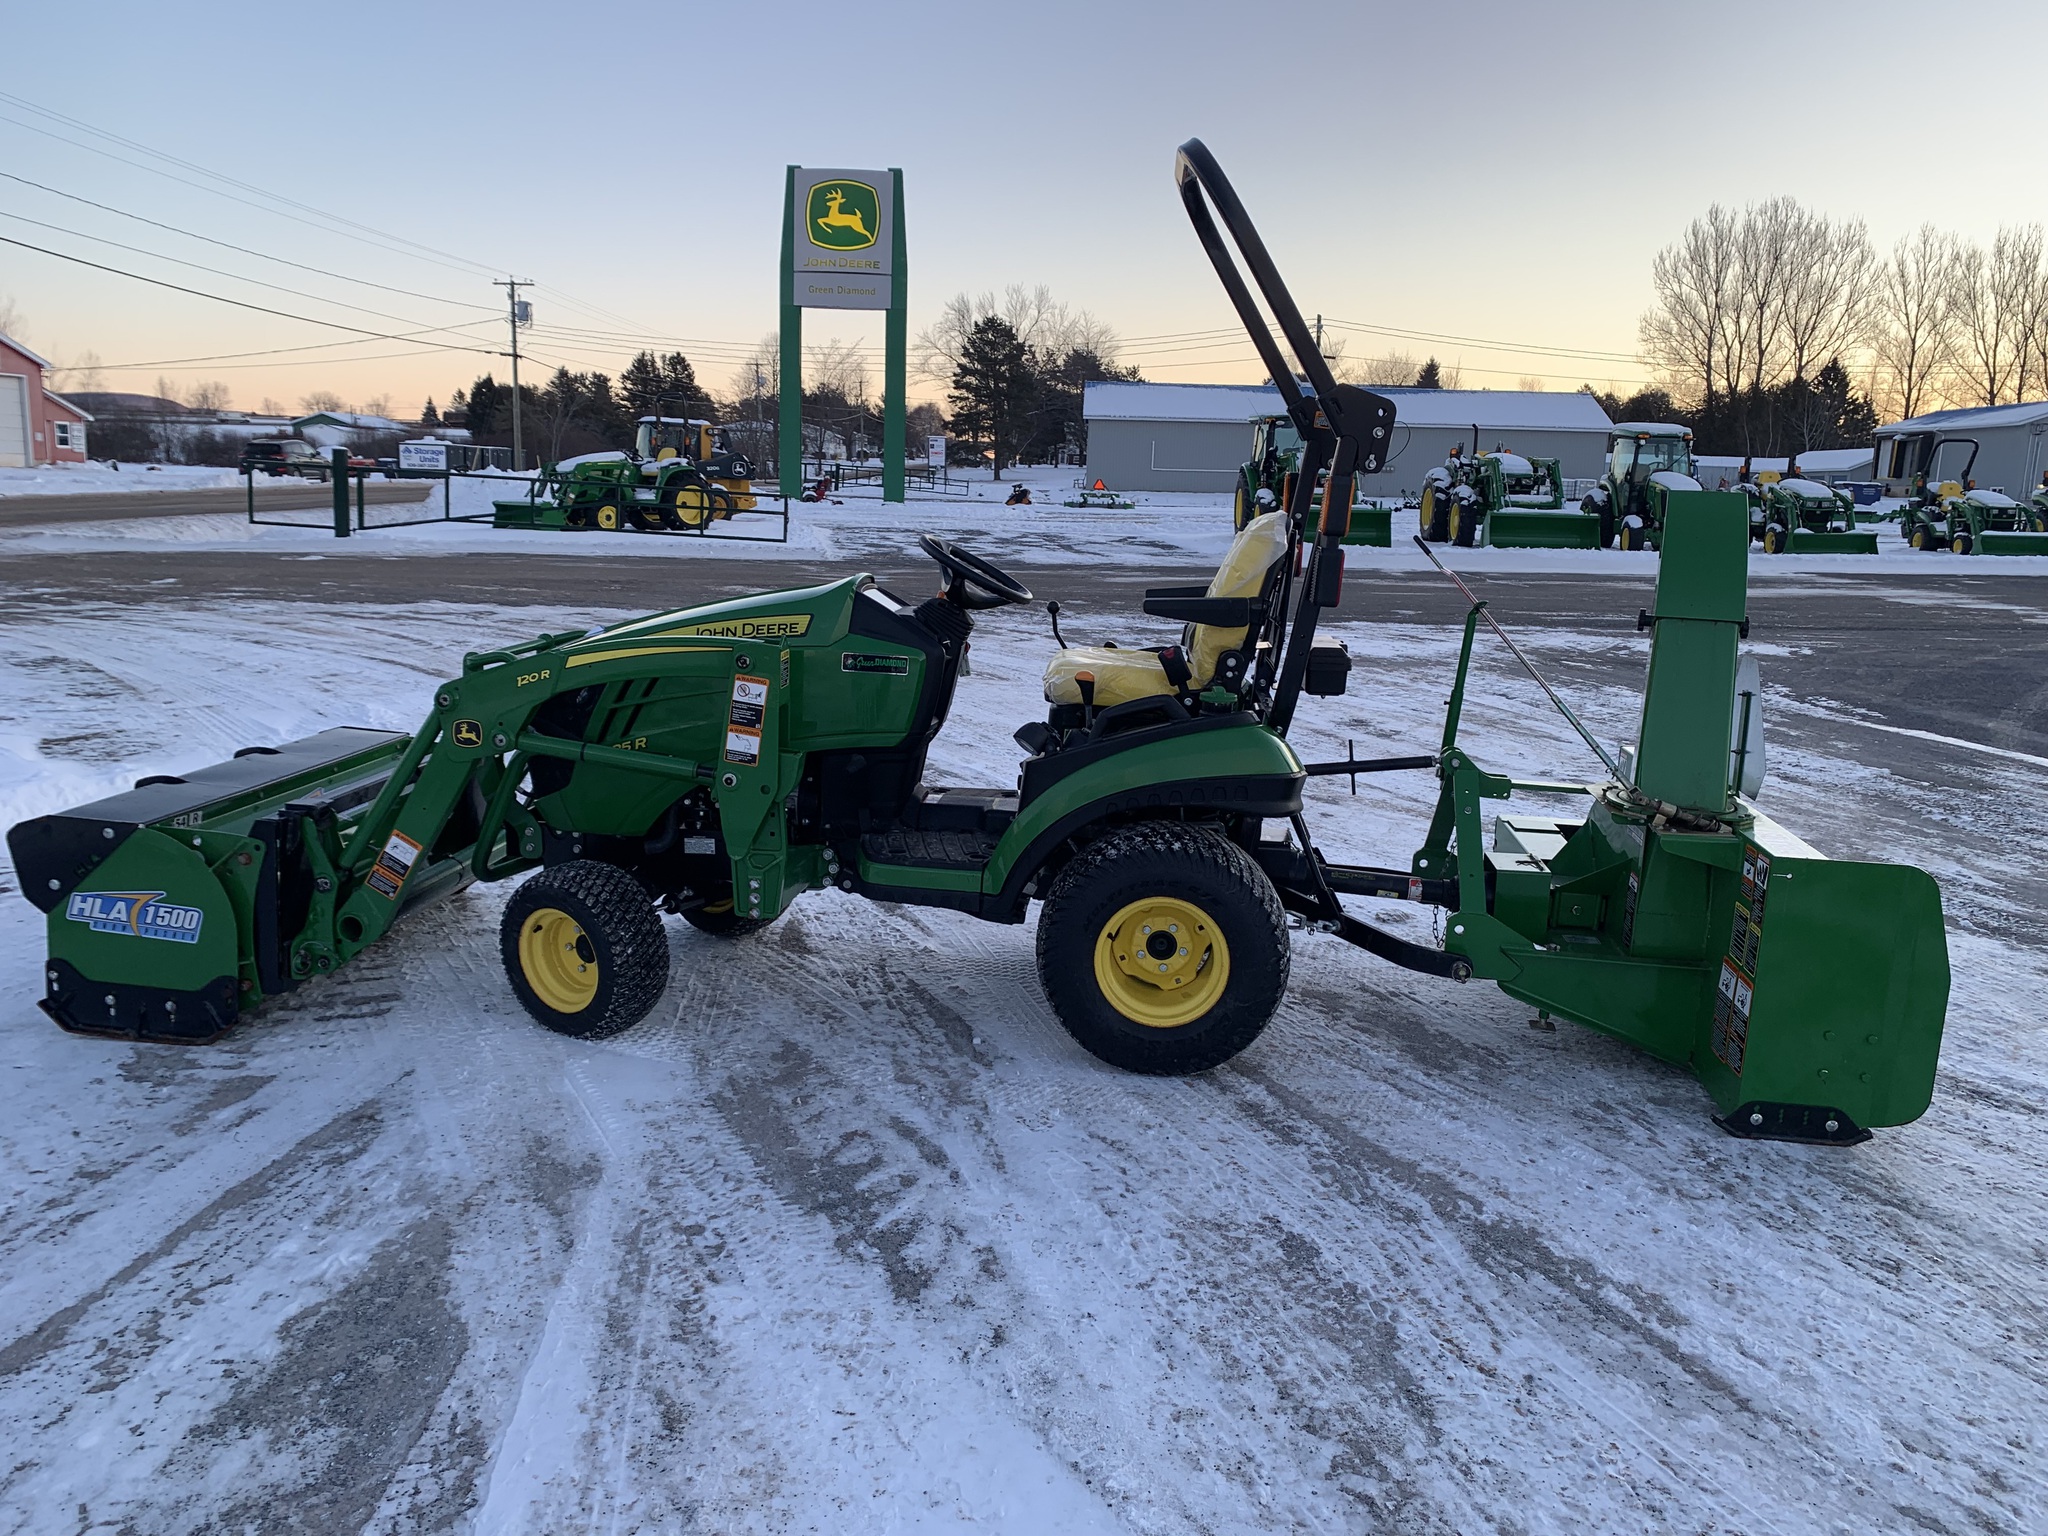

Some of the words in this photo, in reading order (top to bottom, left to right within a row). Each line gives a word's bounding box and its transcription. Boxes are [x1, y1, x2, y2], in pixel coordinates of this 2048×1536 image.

[803, 257, 836, 267] JOHN
[838, 257, 881, 269] DEERE
[808, 285, 834, 294] Green
[837, 285, 876, 296] Diamond
[413, 446, 444, 456] Storage
[419, 455, 440, 463] Units
[741, 622, 799, 637] DEERE
[874, 658, 907, 667] DIAMOND
[516, 672, 539, 687] 120
[540, 669, 551, 680] R
[740, 676, 767, 685] WARNING
[733, 727, 760, 737] WARNING
[71, 895, 128, 921] HLA
[144, 906, 199, 929] 1500
